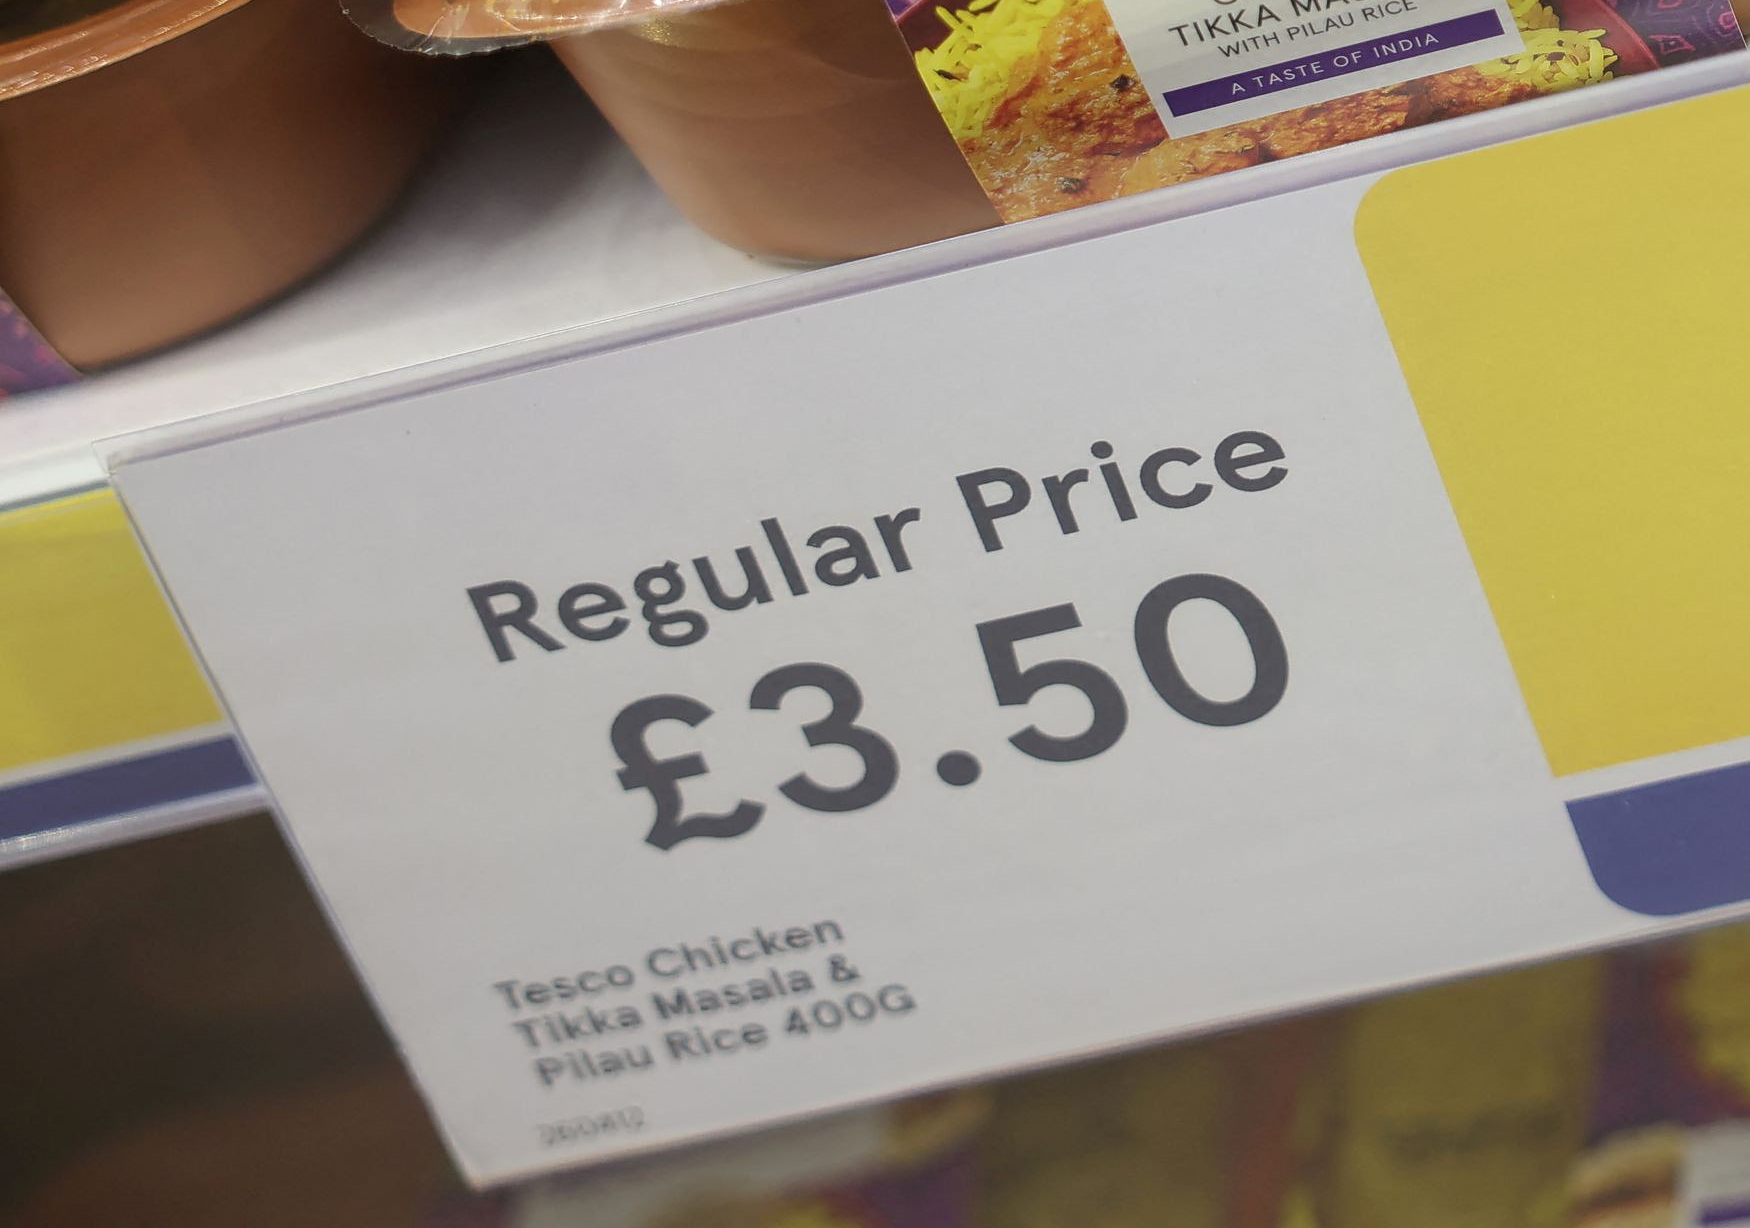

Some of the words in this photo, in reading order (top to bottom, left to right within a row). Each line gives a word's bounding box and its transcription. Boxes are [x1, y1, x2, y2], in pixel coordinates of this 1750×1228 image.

[1168, 3, 1281, 47] TIKKA
[1218, 31, 1281, 58] WITH
[1289, 13, 1355, 42] PILAU
[1231, 81, 1247, 96] A
[1253, 62, 1324, 89] TASTE
[1333, 50, 1363, 69] OF
[1373, 33, 1440, 60] INDIA
[466, 507, 921, 663] Regular
[955, 428, 1289, 552] Price
[610, 572, 1289, 851] £3.50
[494, 964, 636, 1011] Tesco
[645, 918, 845, 979] Chicken
[512, 1003, 644, 1048] Tikka
[651, 967, 815, 1021] Masala
[827, 953, 860, 984] &
[534, 1045, 654, 1087] Pilau
[664, 1022, 769, 1061] Rice
[784, 983, 917, 1036] 400G
